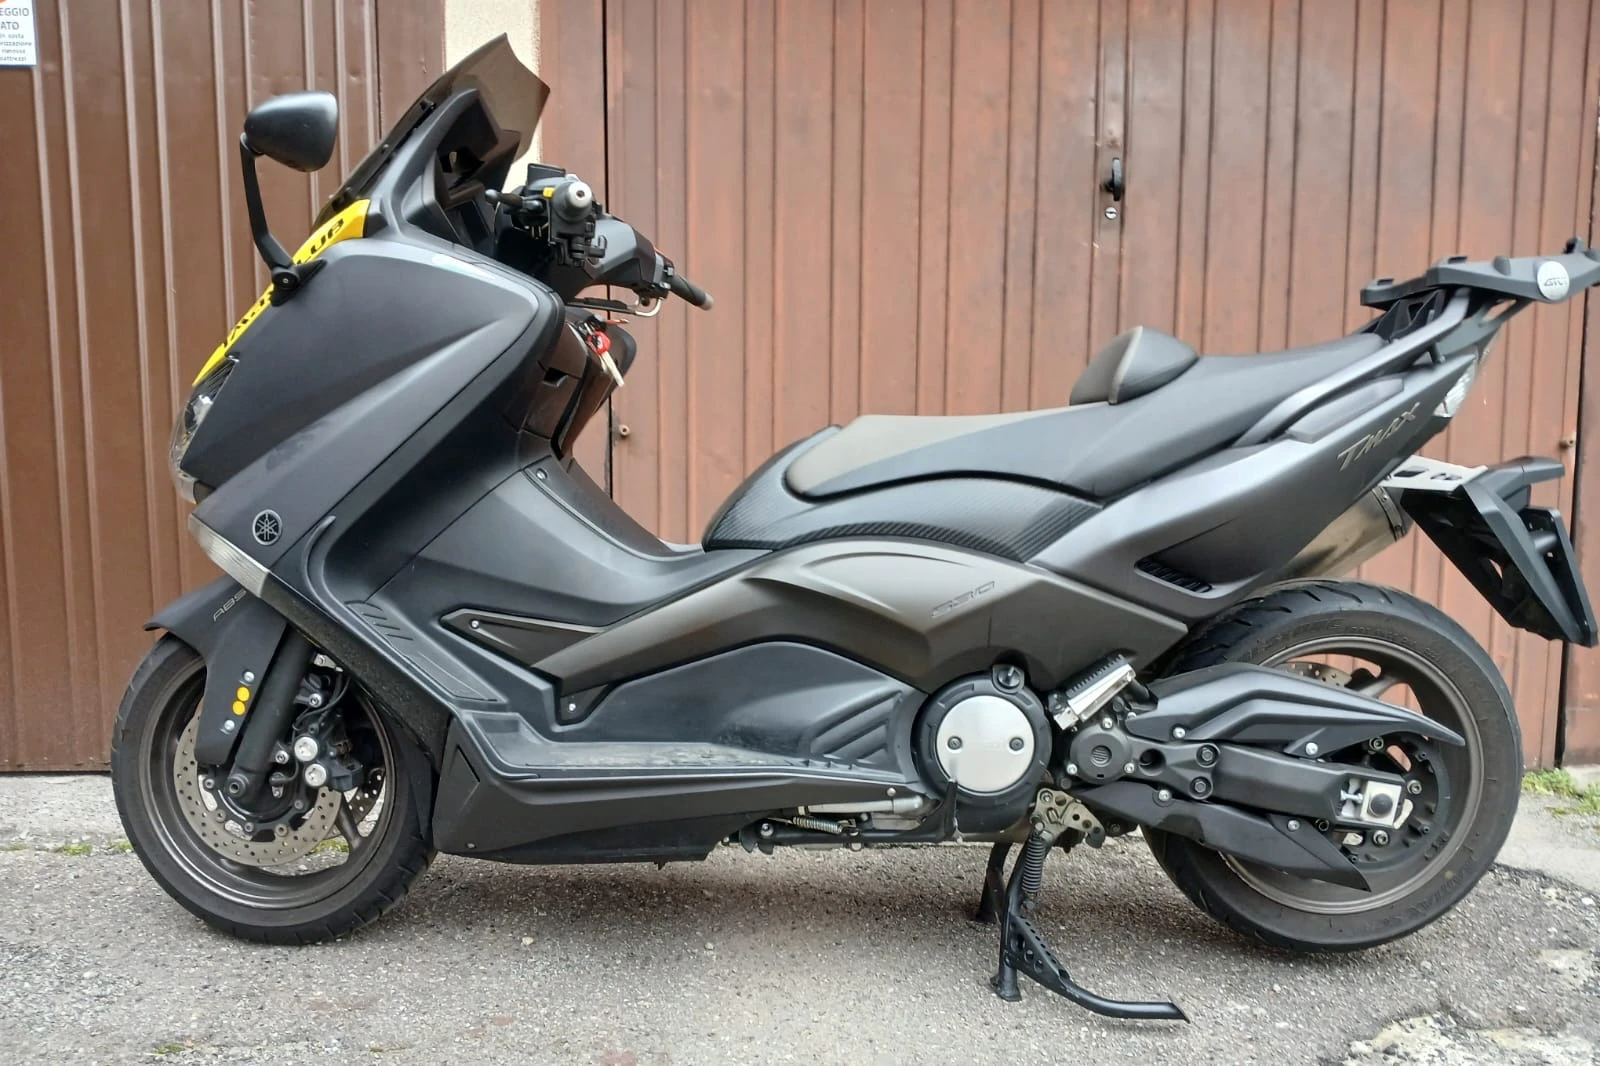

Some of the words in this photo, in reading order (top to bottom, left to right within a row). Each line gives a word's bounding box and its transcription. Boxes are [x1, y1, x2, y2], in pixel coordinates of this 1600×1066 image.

[0, 7, 30, 17] EGGIO
[0, 21, 20, 30] ATO
[213, 588, 247, 622] ABS
[931, 580, 996, 616] 530
